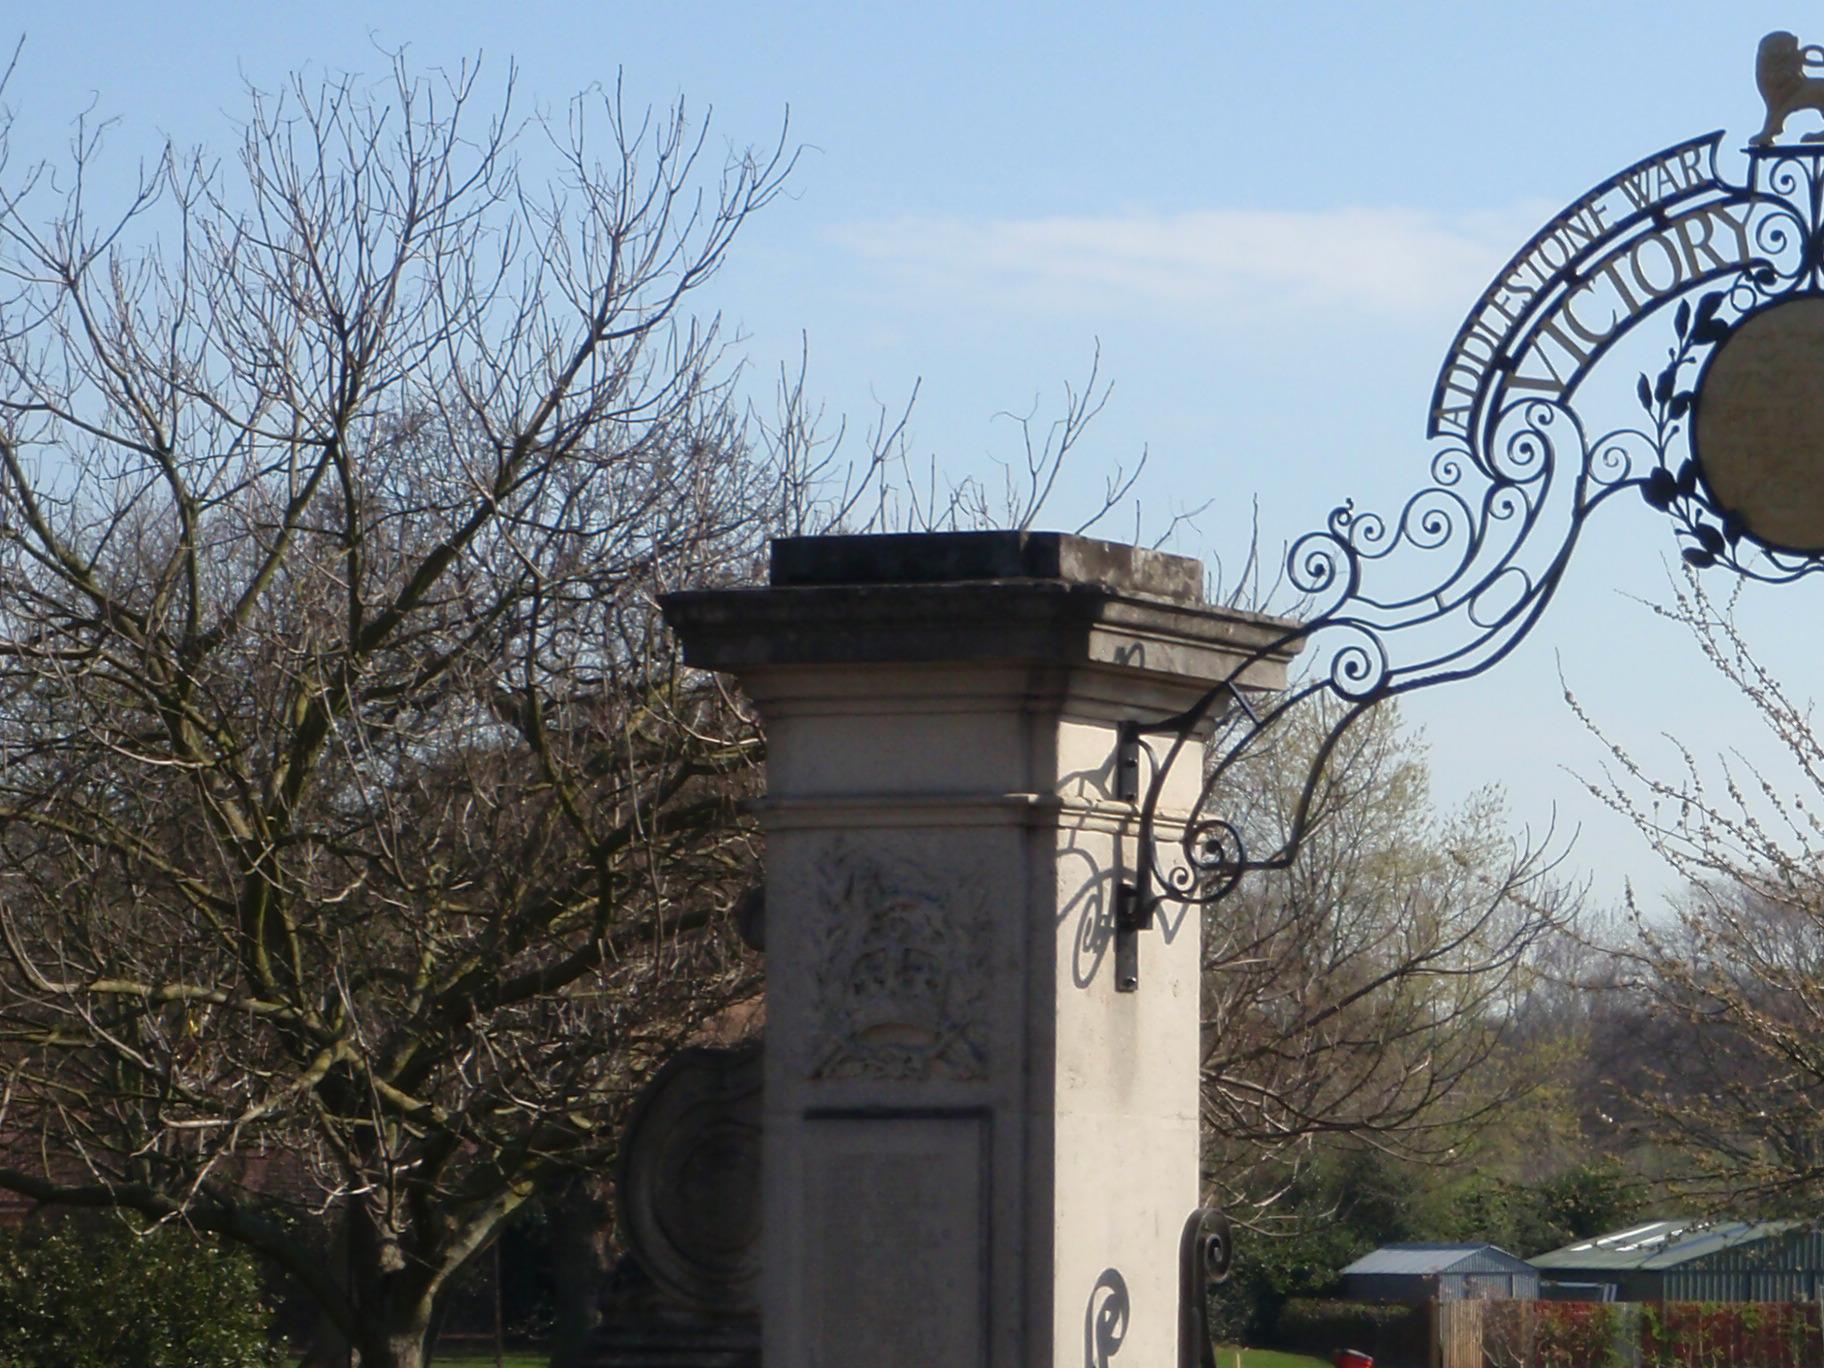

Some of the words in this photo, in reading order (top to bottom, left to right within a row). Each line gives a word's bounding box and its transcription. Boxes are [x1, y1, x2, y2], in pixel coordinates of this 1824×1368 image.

[1432, 200, 1618, 432] ADDLESTONE
[1614, 146, 1706, 213] WAR
[1502, 199, 1759, 395] VICTORY
